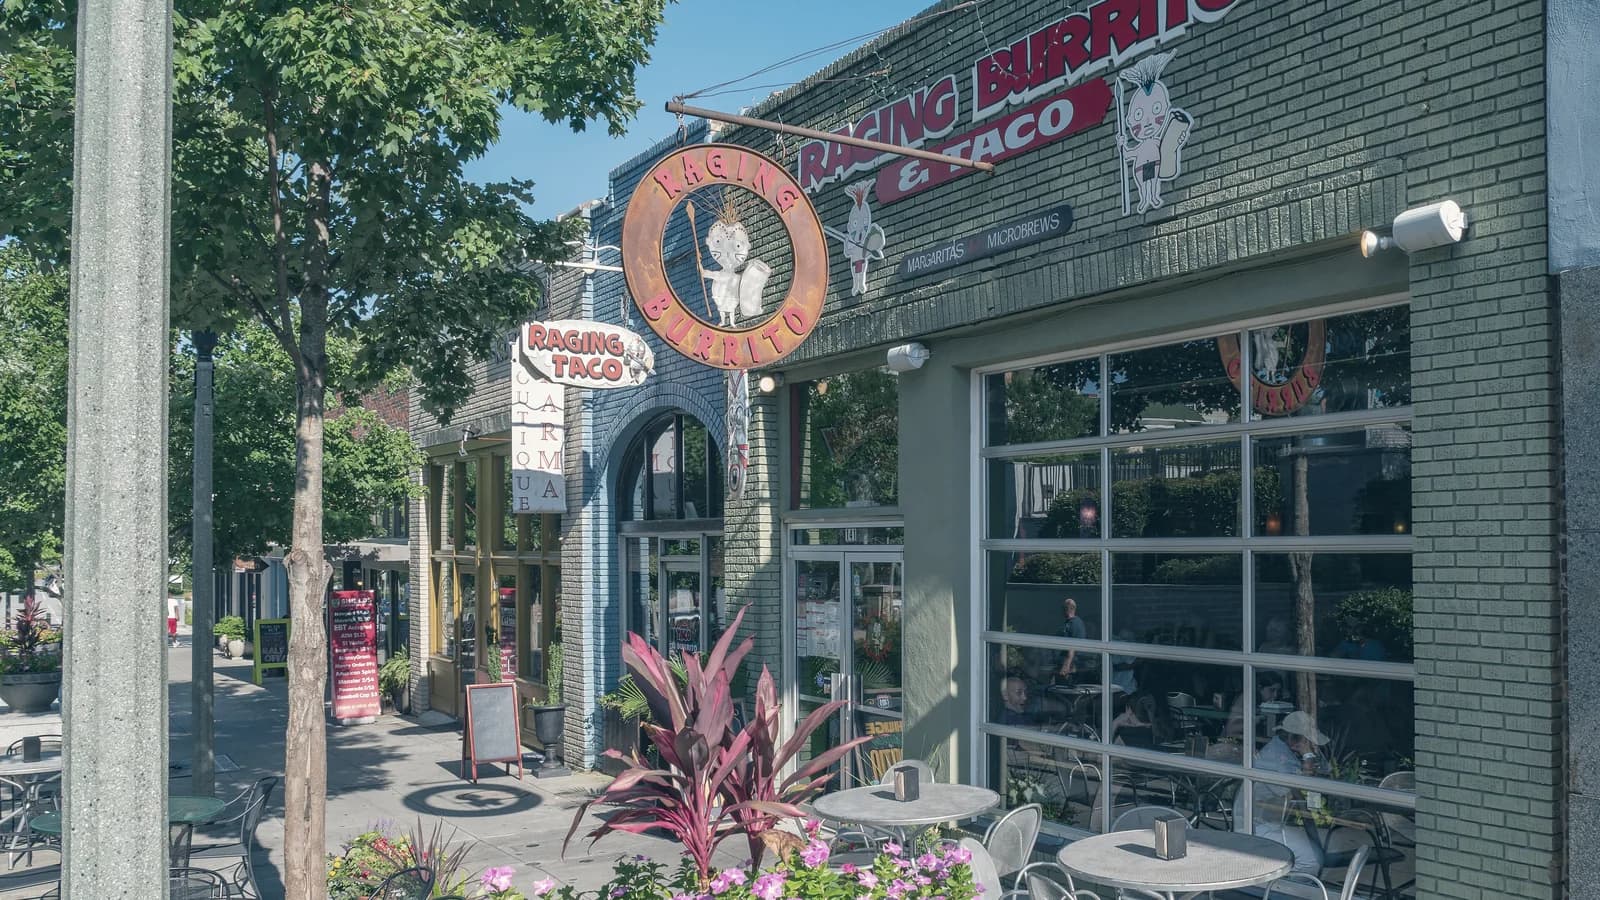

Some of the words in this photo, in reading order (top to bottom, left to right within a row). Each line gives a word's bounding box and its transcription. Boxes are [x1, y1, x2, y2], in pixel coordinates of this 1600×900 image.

[799, 75, 958, 192] RAGING
[899, 160, 928, 191] &
[943, 99, 1073, 172] TACO
[653, 149, 799, 213] RAGING
[987, 212, 1060, 249] MICROBREWS
[528, 324, 625, 356] RAGING
[642, 289, 808, 366] BURRITO
[552, 354, 623, 381] TACO
[516, 370, 530, 511] OUTIQUE
[538, 387, 562, 498] ARMA
